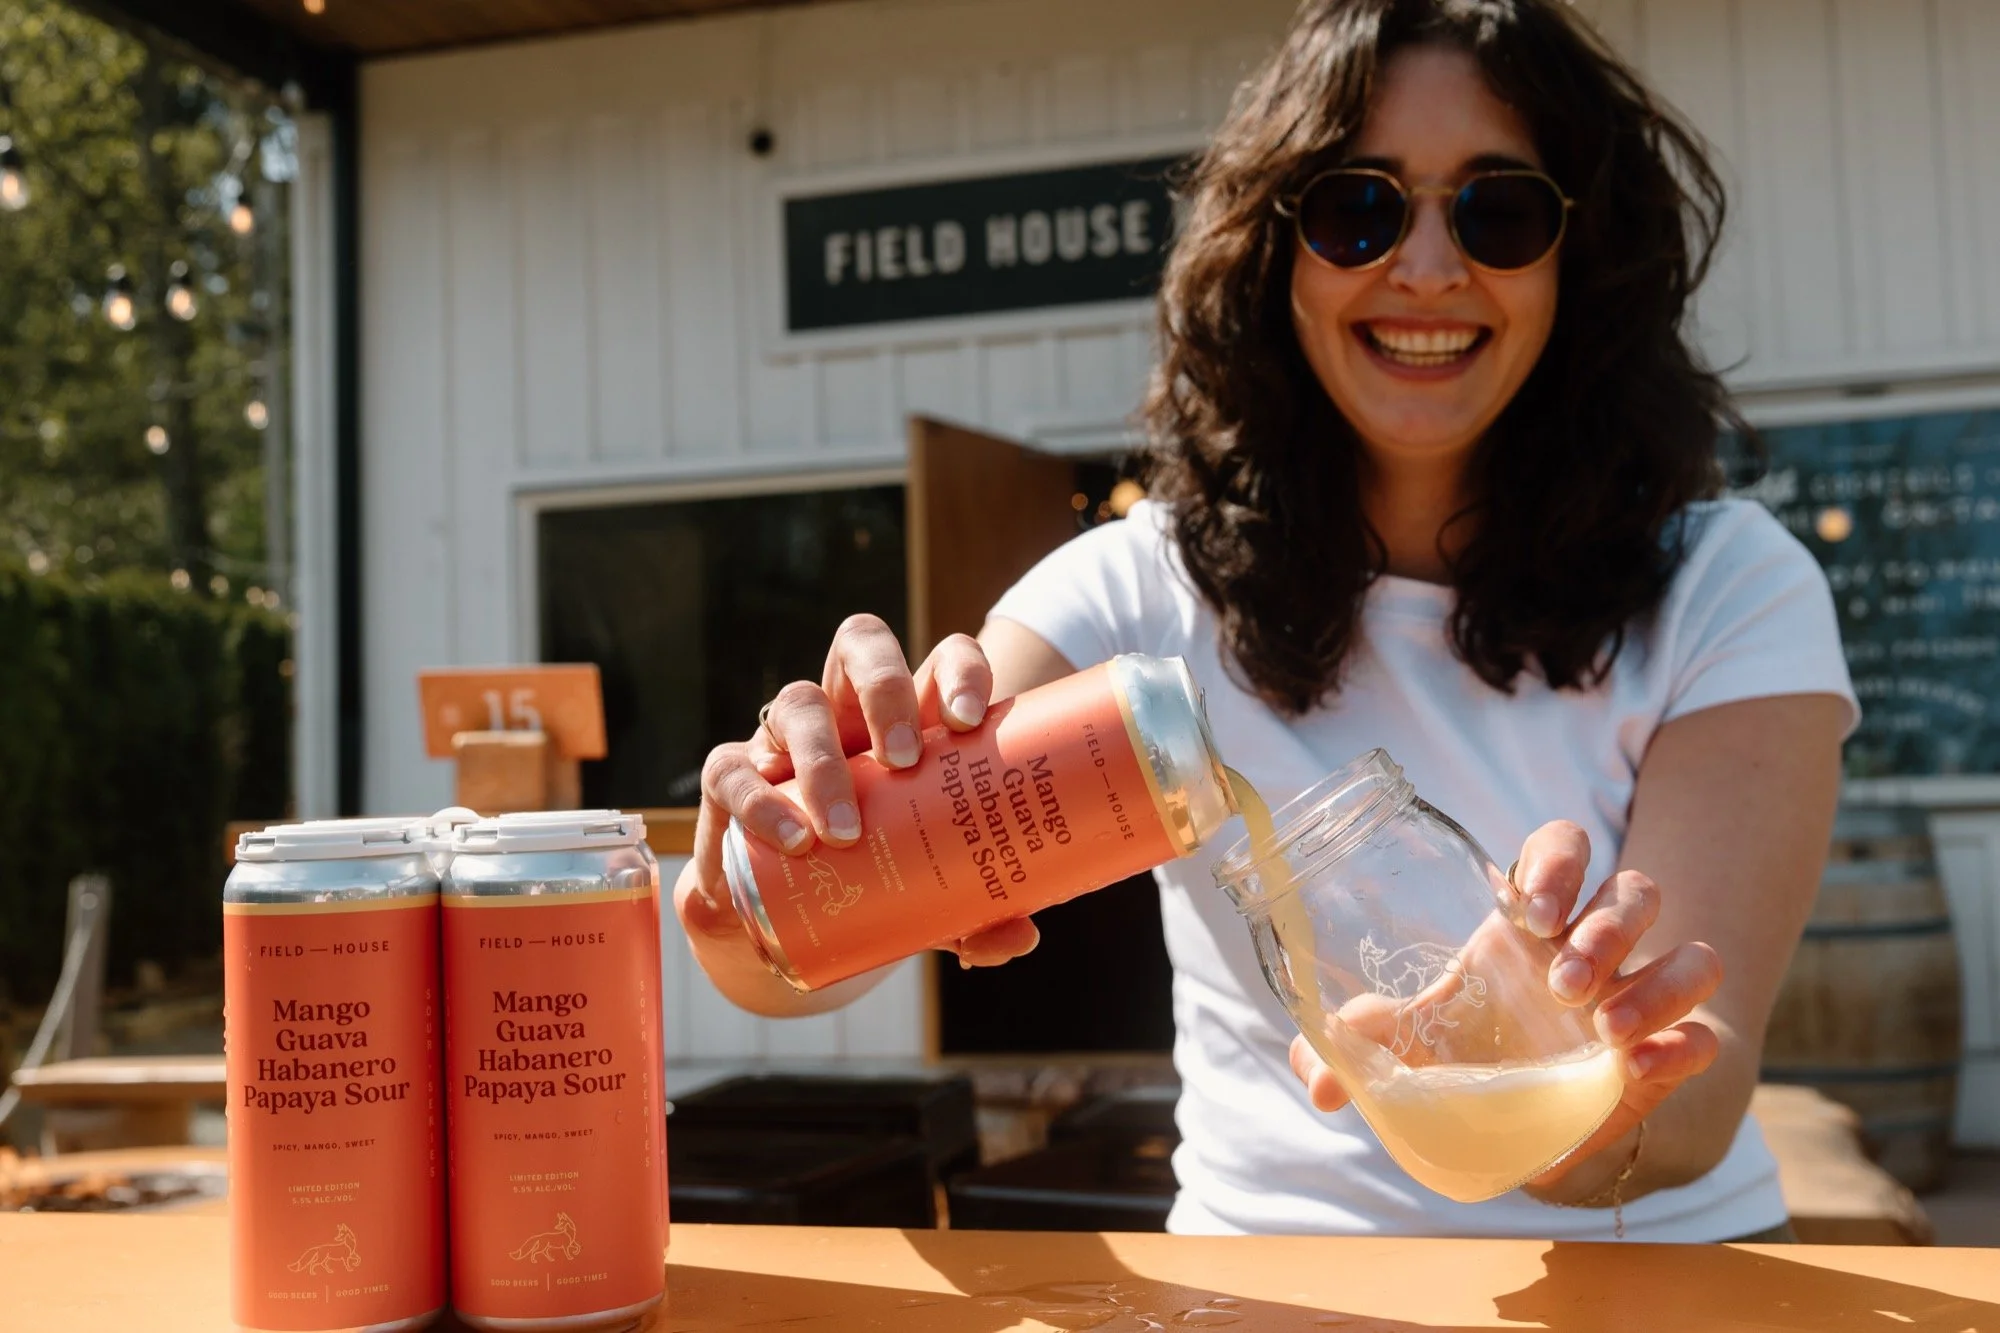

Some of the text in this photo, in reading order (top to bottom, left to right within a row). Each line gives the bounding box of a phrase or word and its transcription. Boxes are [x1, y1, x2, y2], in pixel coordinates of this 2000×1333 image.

[824, 200, 1153, 286] FIELD HOUSE
[481, 688, 543, 732] 15
[1082, 723, 1135, 841] FIELD HOUSE
[1002, 767, 1044, 854] Guava
[1027, 752, 1072, 845] Mango
[939, 750, 1009, 901] Papaya Sour
[968, 756, 1027, 884] Habanero
[933, 864, 949, 890] SWEET
[260, 940, 390, 957] FIELD HOUSE
[479, 932, 606, 949] FIELD HOUSE
[273, 1000, 371, 1026] Mango
[493, 991, 588, 1017] Mango
[276, 1028, 368, 1051] Guava
[496, 1020, 585, 1043] Guava
[257, 1056, 396, 1081] Habanero
[478, 1048, 613, 1071] Habanero
[244, 1081, 410, 1115] Papaya Sour
[464, 1071, 626, 1105] Papaya Sour
[272, 1138, 376, 1152] SPICY, MANGO, SWEET
[494, 1128, 594, 1142] SPICY, MANGO, SWEET
[288, 1181, 360, 1193] LIMITED EDITION
[509, 1171, 579, 1182] LIMITED EDITION
[335, 1284, 389, 1298] GOOD TIMES
[556, 1271, 608, 1286] GOOD TIMES
